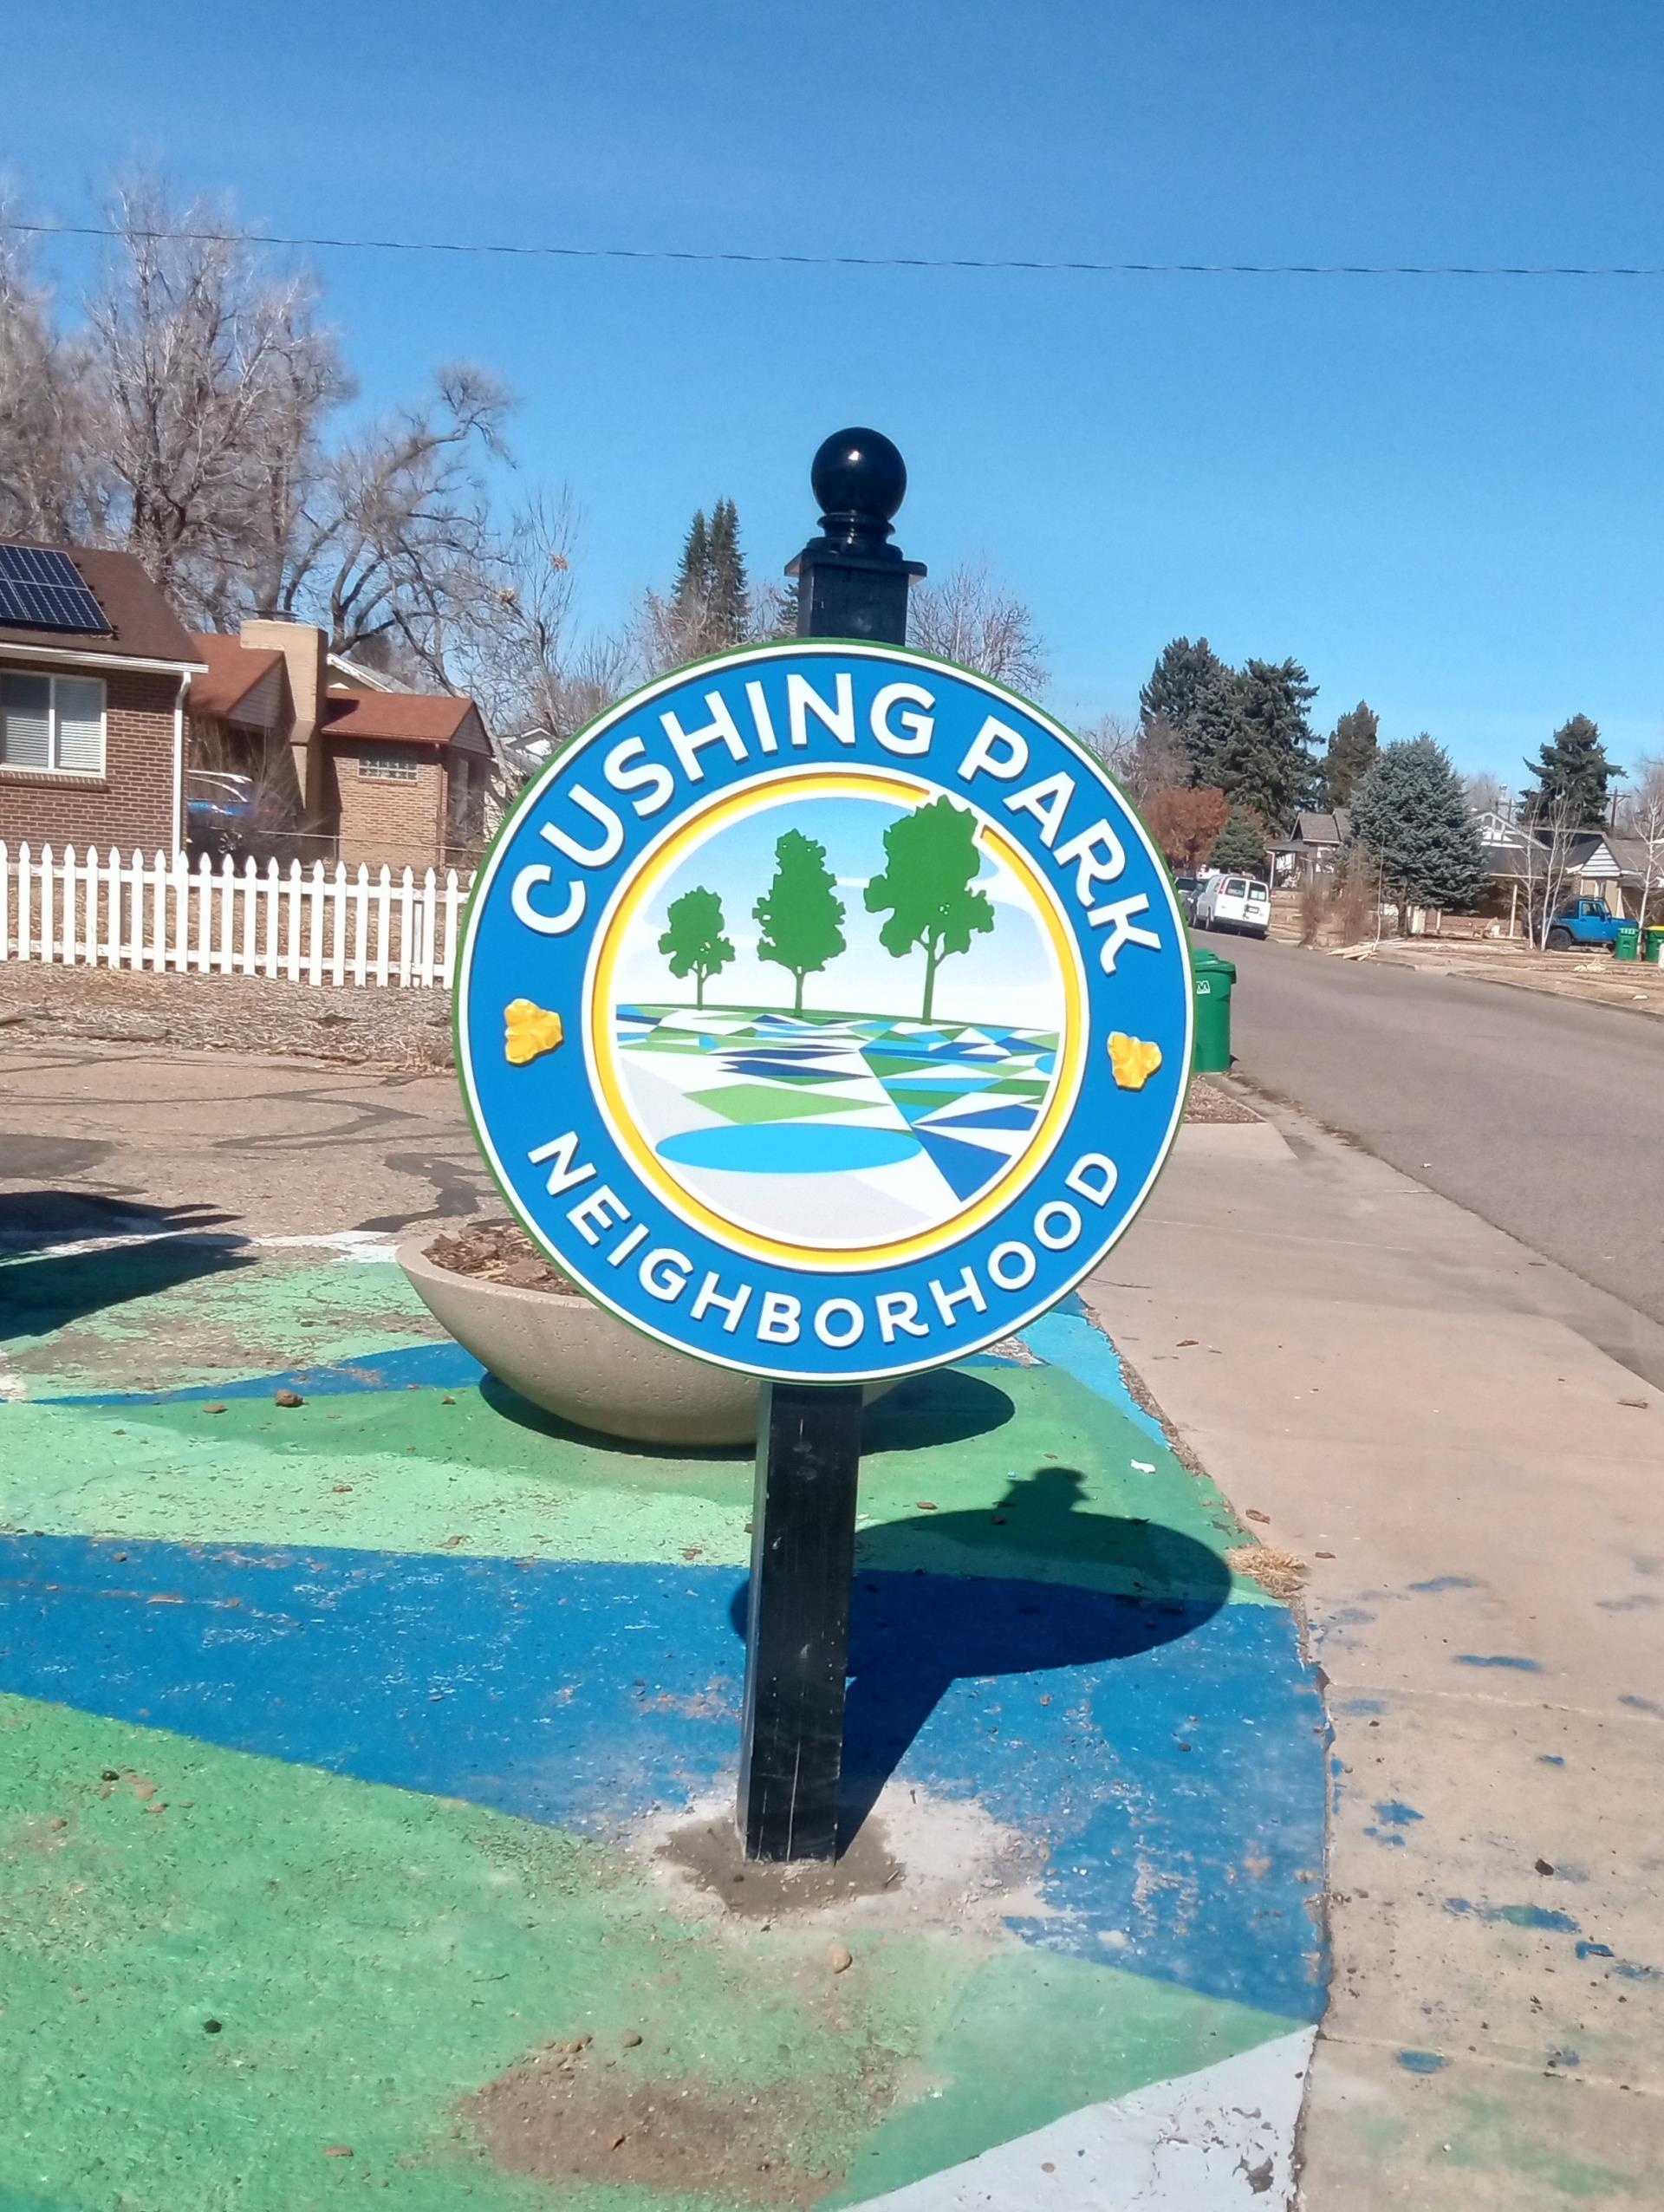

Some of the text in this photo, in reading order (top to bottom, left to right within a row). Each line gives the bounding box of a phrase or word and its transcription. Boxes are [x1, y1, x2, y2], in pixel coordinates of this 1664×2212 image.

[511, 673, 1162, 975] CUSHING PARK
[527, 1130, 1119, 1349] NEIGHBORHOOD
